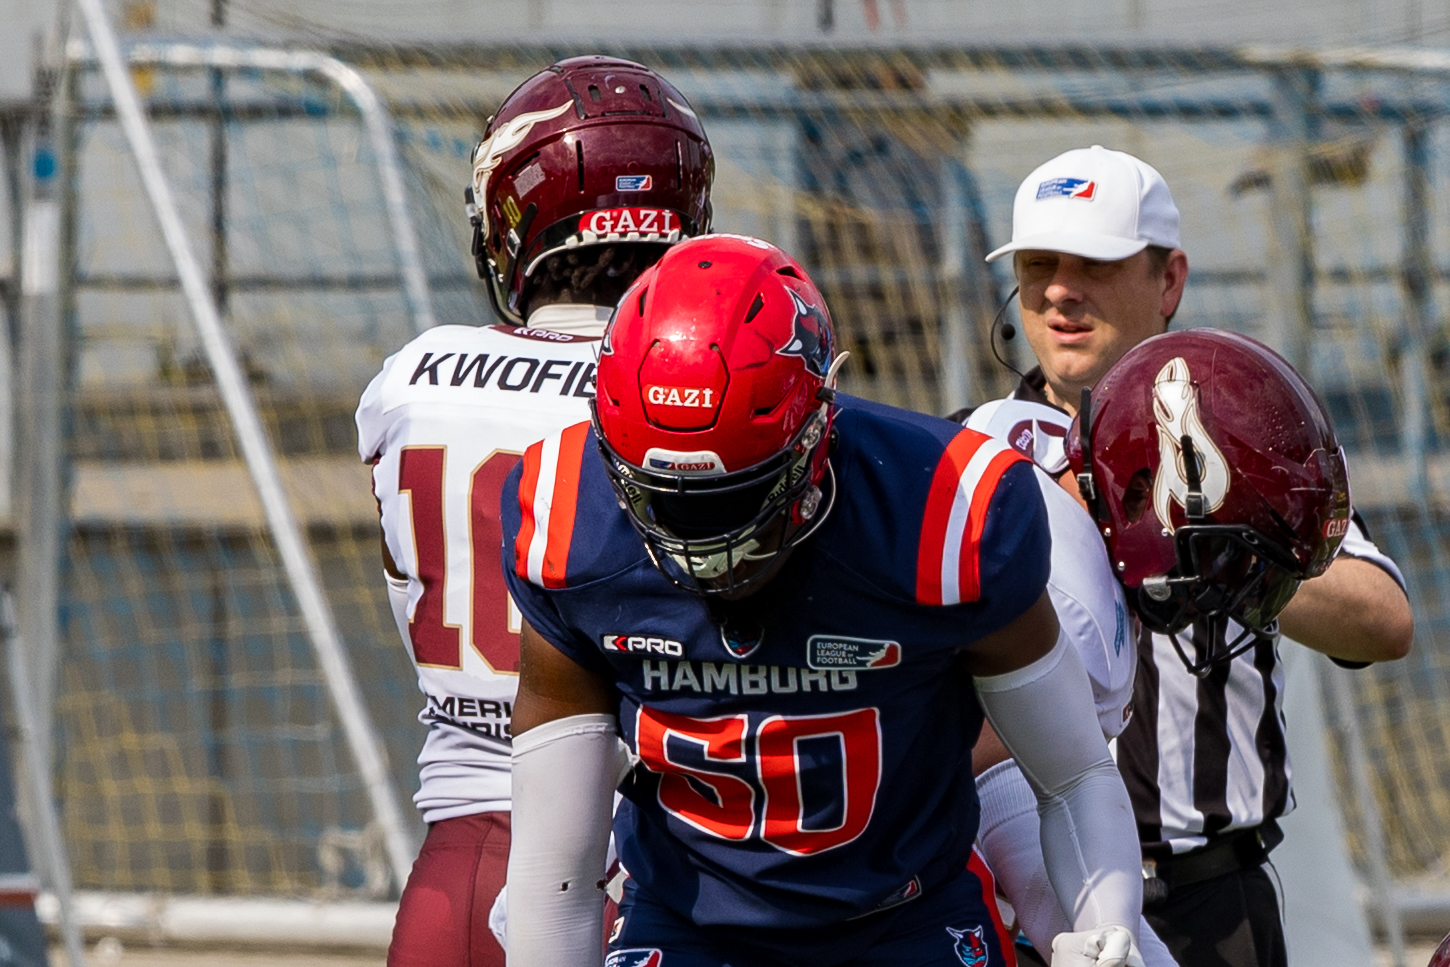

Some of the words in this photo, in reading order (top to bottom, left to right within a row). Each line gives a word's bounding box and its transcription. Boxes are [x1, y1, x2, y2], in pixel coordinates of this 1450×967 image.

[409, 352, 597, 398] KWOFIE
[816, 642, 859, 652] EUROPEAN
[816, 656, 857, 665] FOOTBALL
[642, 659, 859, 696] HAMBURG
